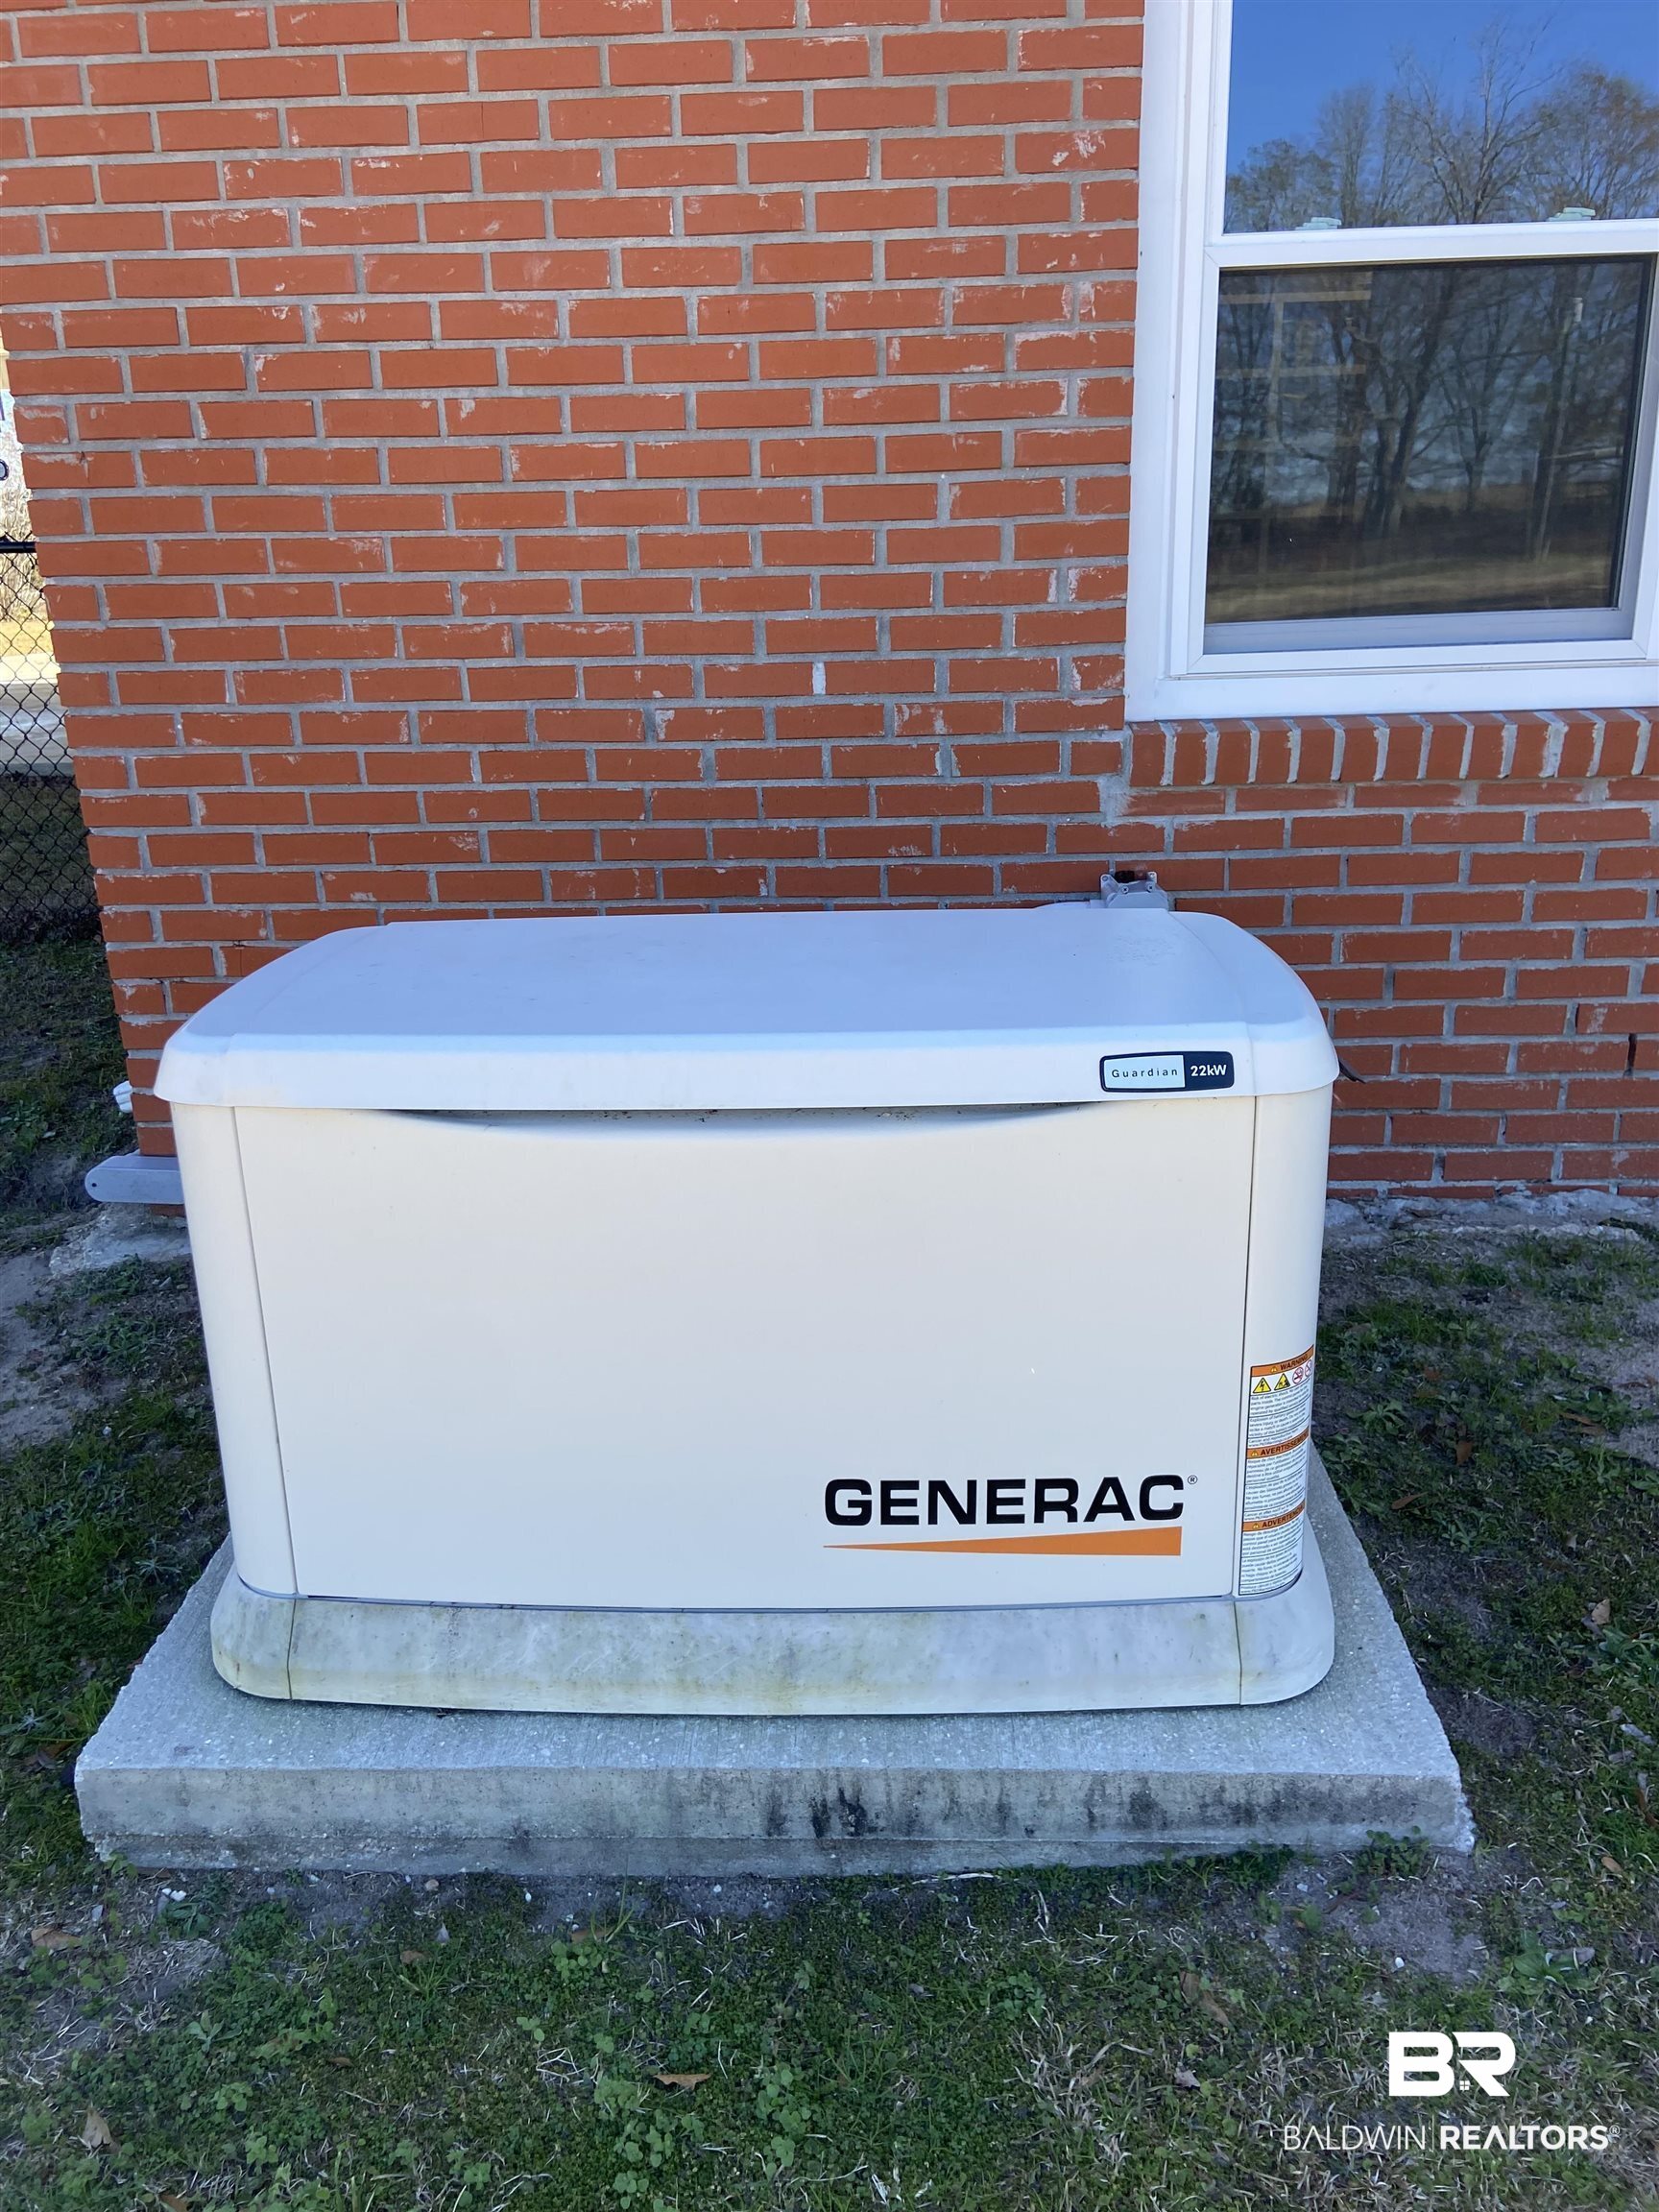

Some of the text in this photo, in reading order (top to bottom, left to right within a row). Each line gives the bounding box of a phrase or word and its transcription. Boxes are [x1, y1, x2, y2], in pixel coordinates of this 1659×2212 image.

[1111, 1068, 1178, 1078] Guardian
[1190, 1064, 1227, 1077] 22kW
[1280, 1354, 1309, 1370] WARNING
